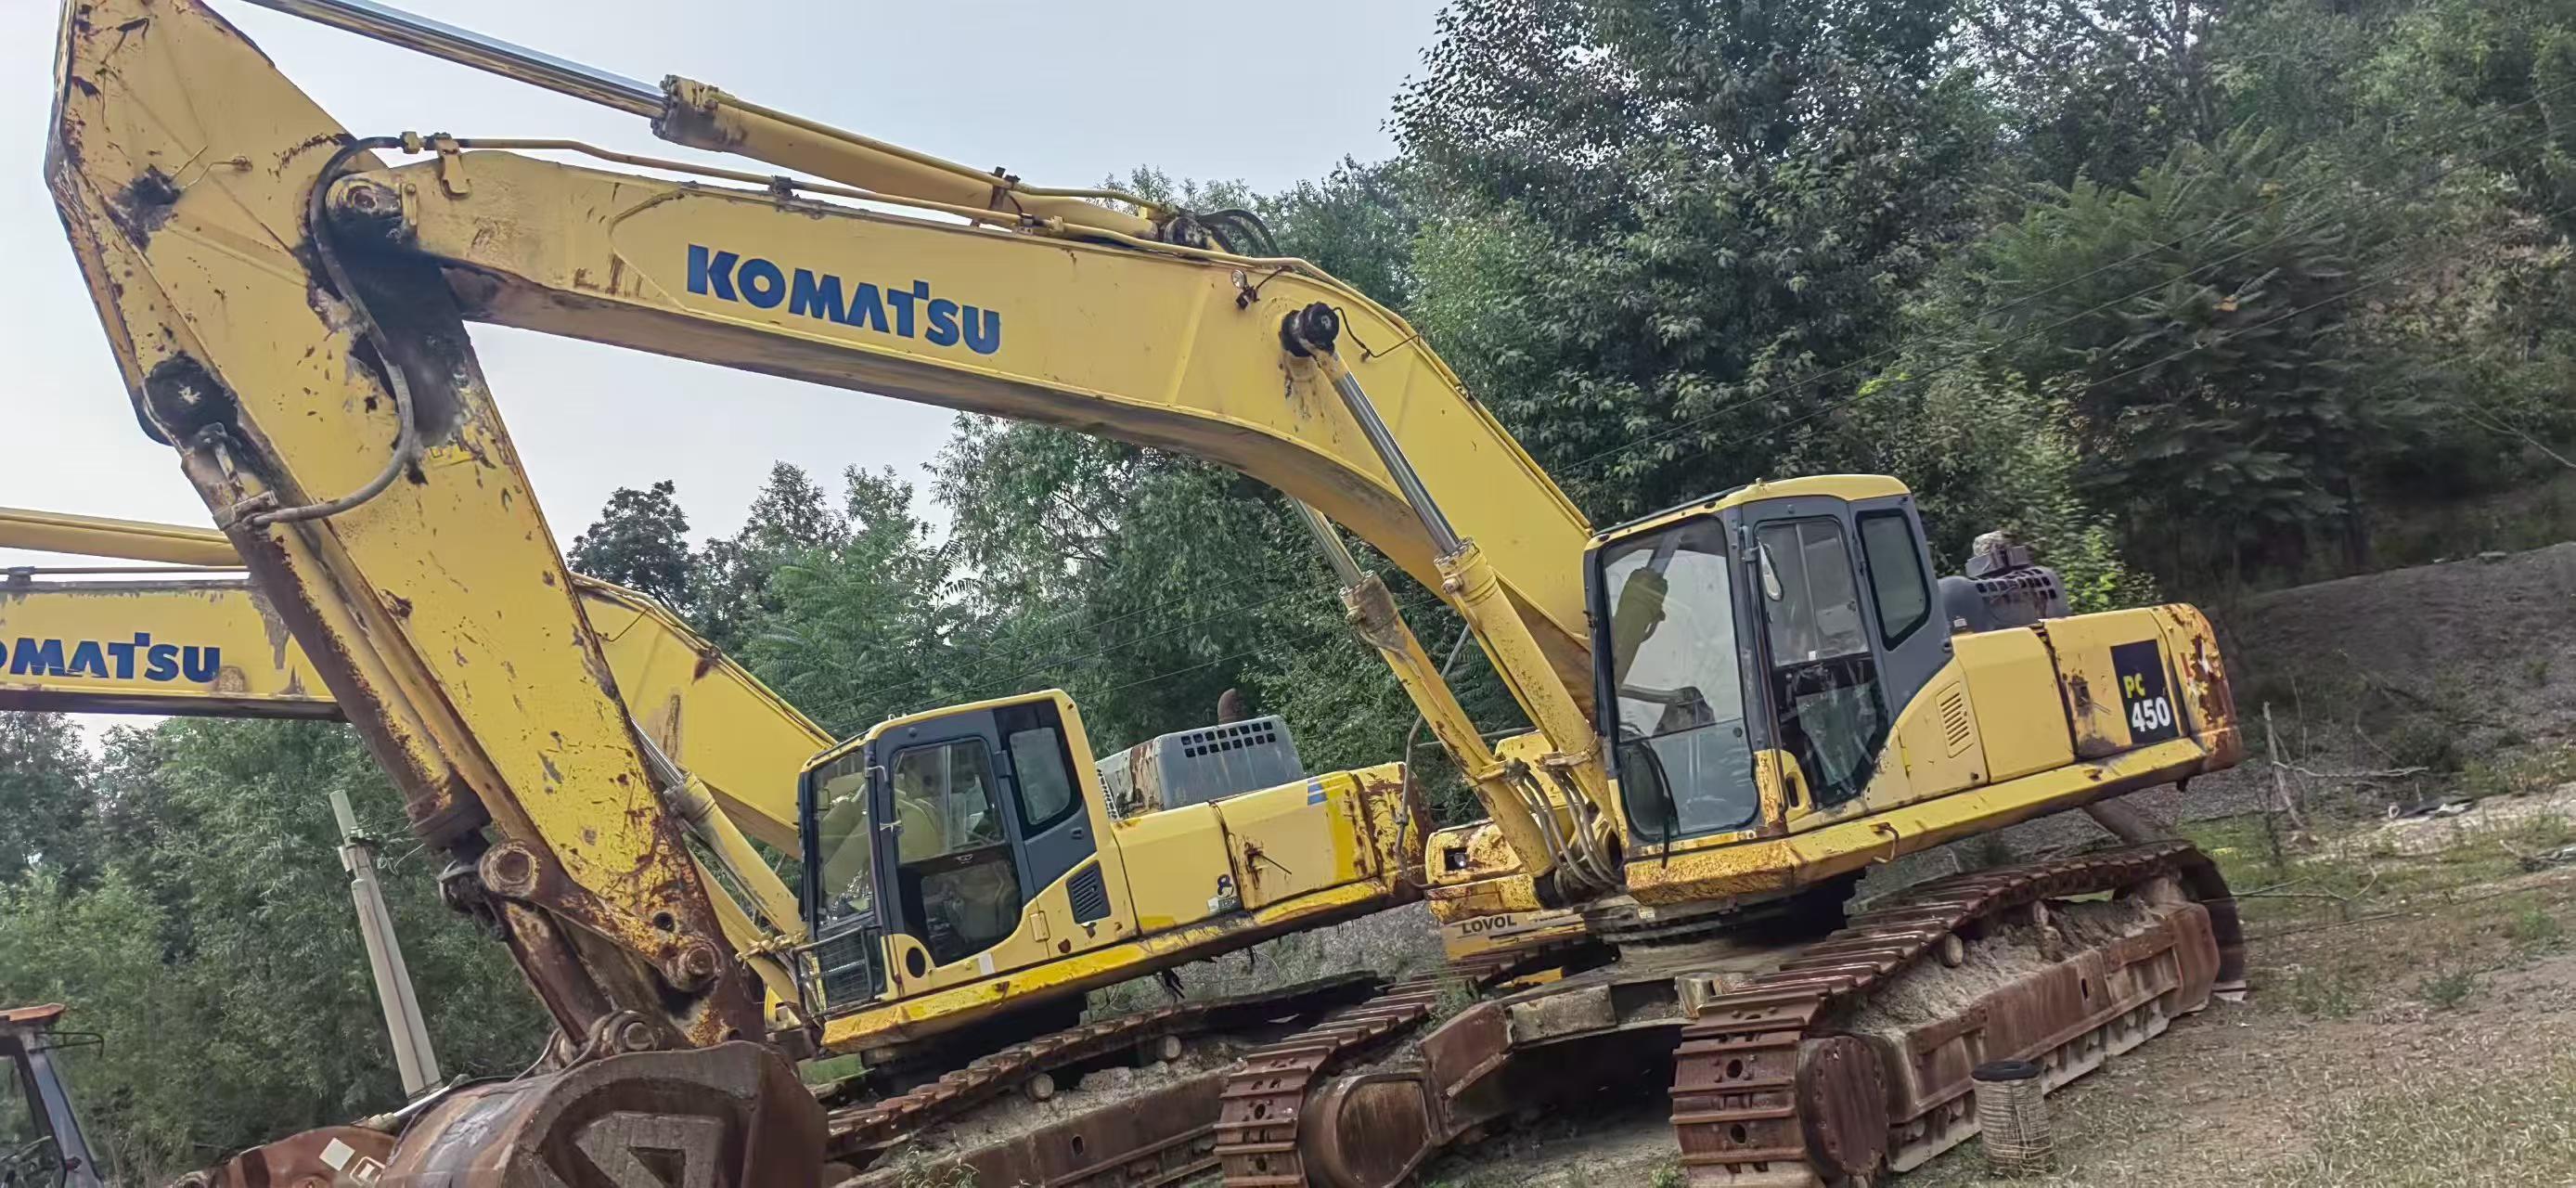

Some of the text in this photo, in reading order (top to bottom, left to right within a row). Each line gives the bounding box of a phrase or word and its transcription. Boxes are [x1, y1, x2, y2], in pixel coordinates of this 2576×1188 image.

[687, 243, 1001, 355] KOMATSU
[0, 632, 221, 683] MATSU
[2122, 673, 2145, 698] PC
[2132, 697, 2171, 732] 450
[1462, 914, 1517, 935] LOVOL
